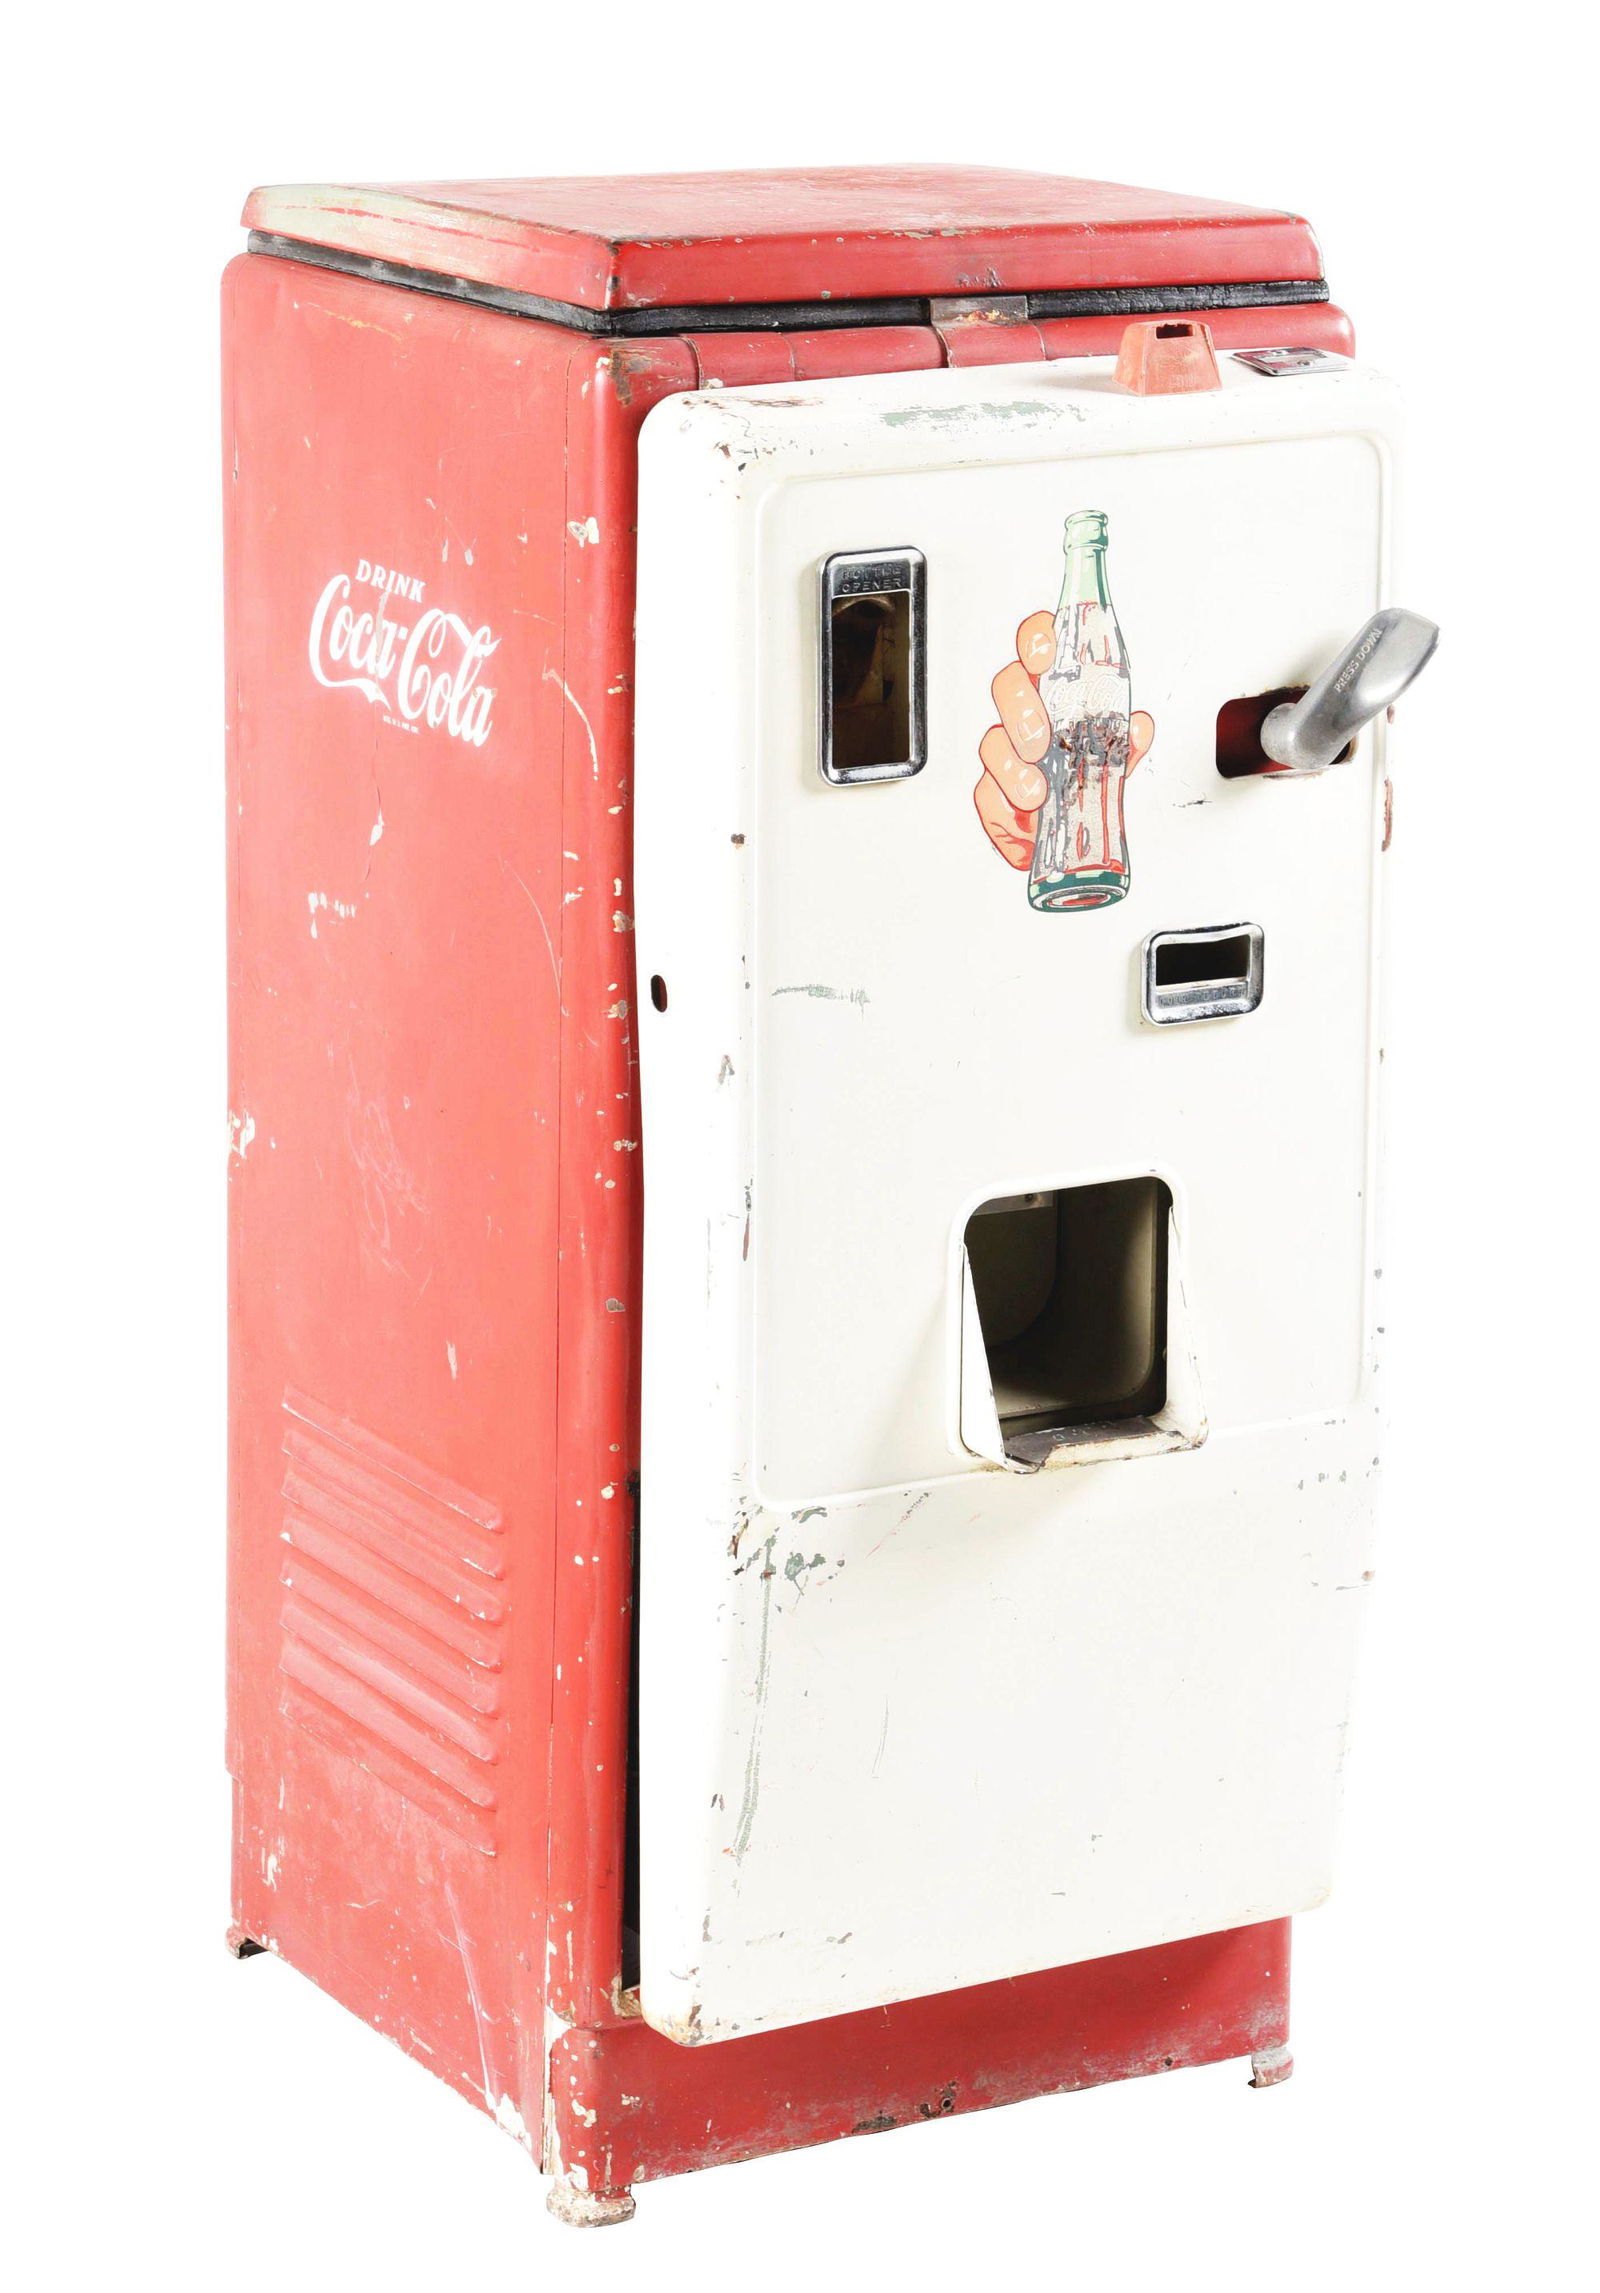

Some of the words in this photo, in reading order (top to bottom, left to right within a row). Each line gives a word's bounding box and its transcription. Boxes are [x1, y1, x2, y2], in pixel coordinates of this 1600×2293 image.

[355, 559, 427, 603] DRINK
[842, 578, 902, 593] OPENER
[309, 574, 503, 747] Coca-Cola
[1334, 660, 1360, 693] PRESS
[1356, 628, 1383, 660] DOWN
